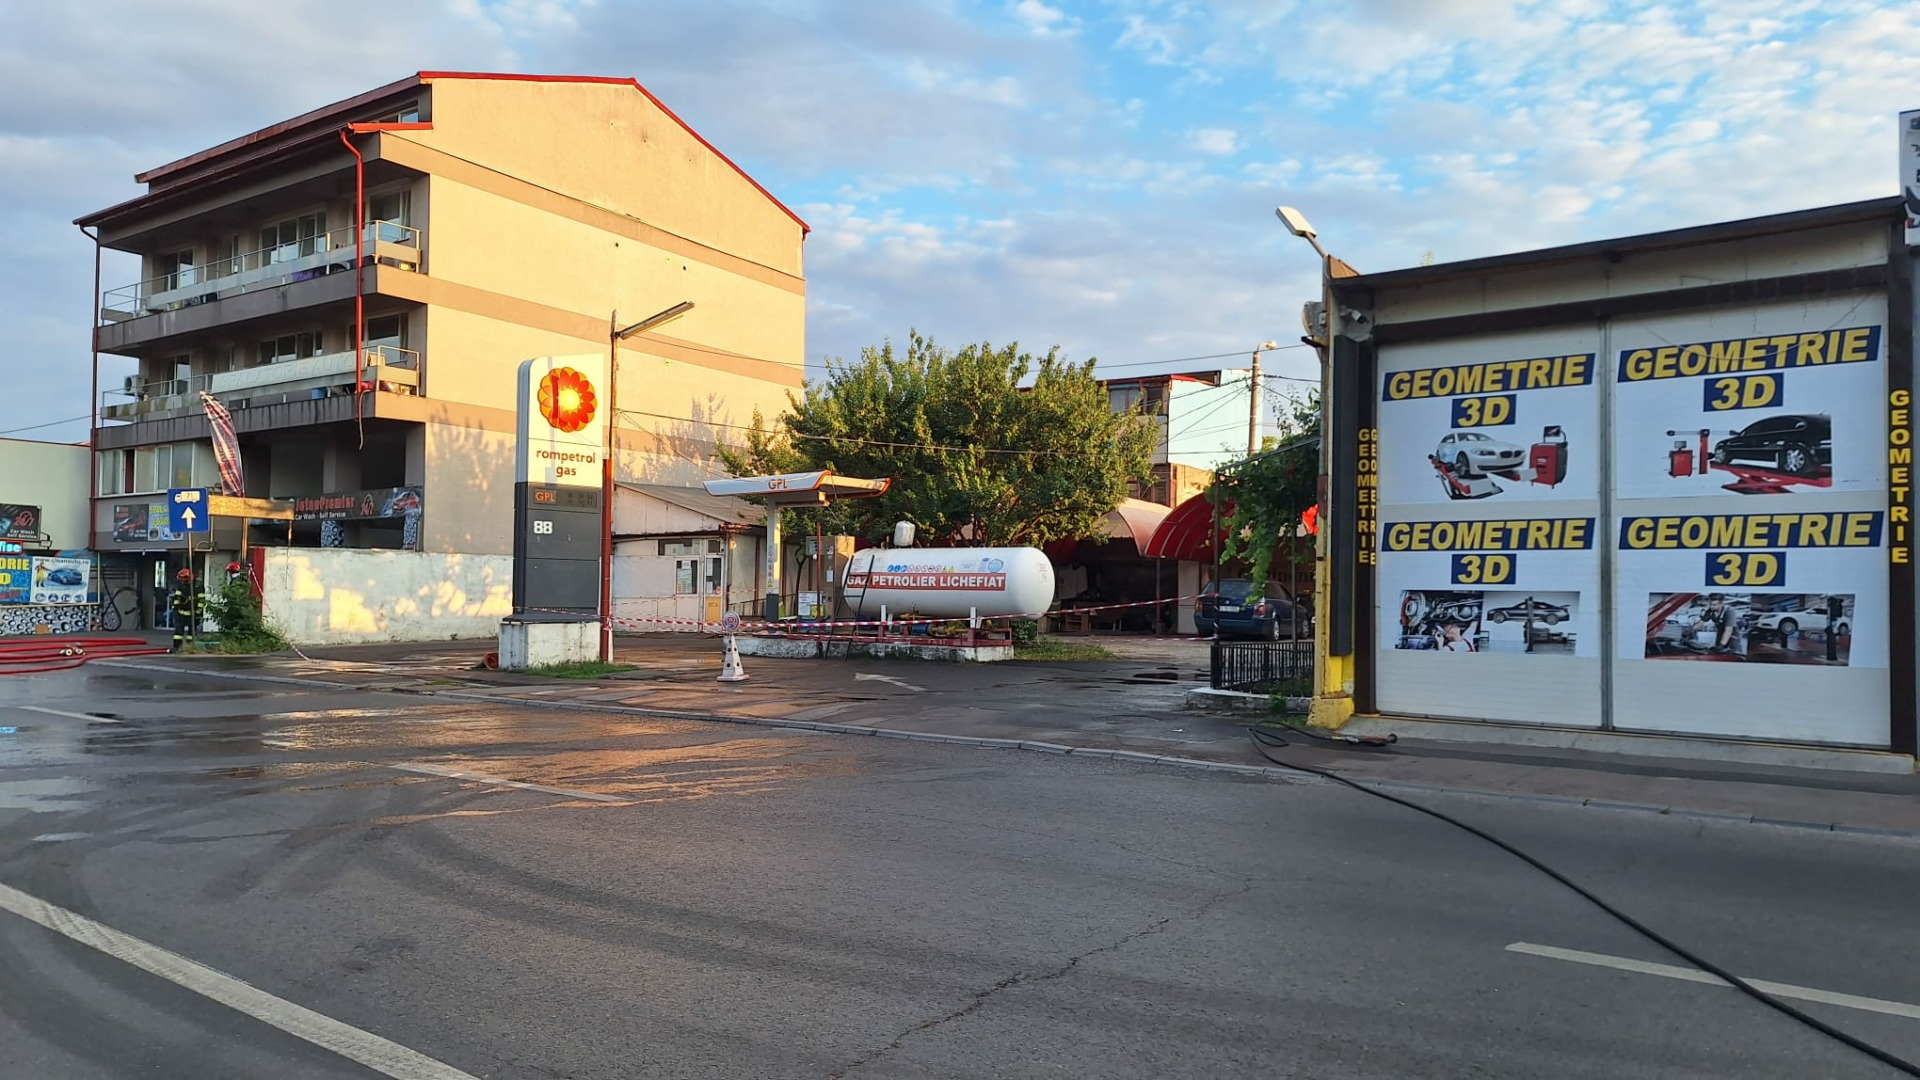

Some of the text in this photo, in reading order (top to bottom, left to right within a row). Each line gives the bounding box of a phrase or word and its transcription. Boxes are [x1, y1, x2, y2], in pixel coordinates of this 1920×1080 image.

[1621, 328, 1870, 381] GEOMETRIE
[1389, 355, 1587, 400] GEOMETRIE
[1711, 376, 1776, 410] 3D
[1457, 397, 1510, 427] 3D
[536, 450, 596, 464] rompetrol
[556, 466, 577, 477] gas
[768, 479, 788, 489] GPL
[1889, 390, 1911, 563] GEOMETRIE
[535, 492, 556, 502] GPL
[1357, 428, 1370, 563] GEOMETRIE
[1388, 519, 1587, 551] GEOMETRIE
[1627, 513, 1873, 549] GEOMETRIE
[872, 575, 936, 587] PETROLIER
[940, 576, 1005, 588] LICHEFIAT
[1457, 555, 1510, 583] 3D
[1713, 553, 1778, 585] 3D
